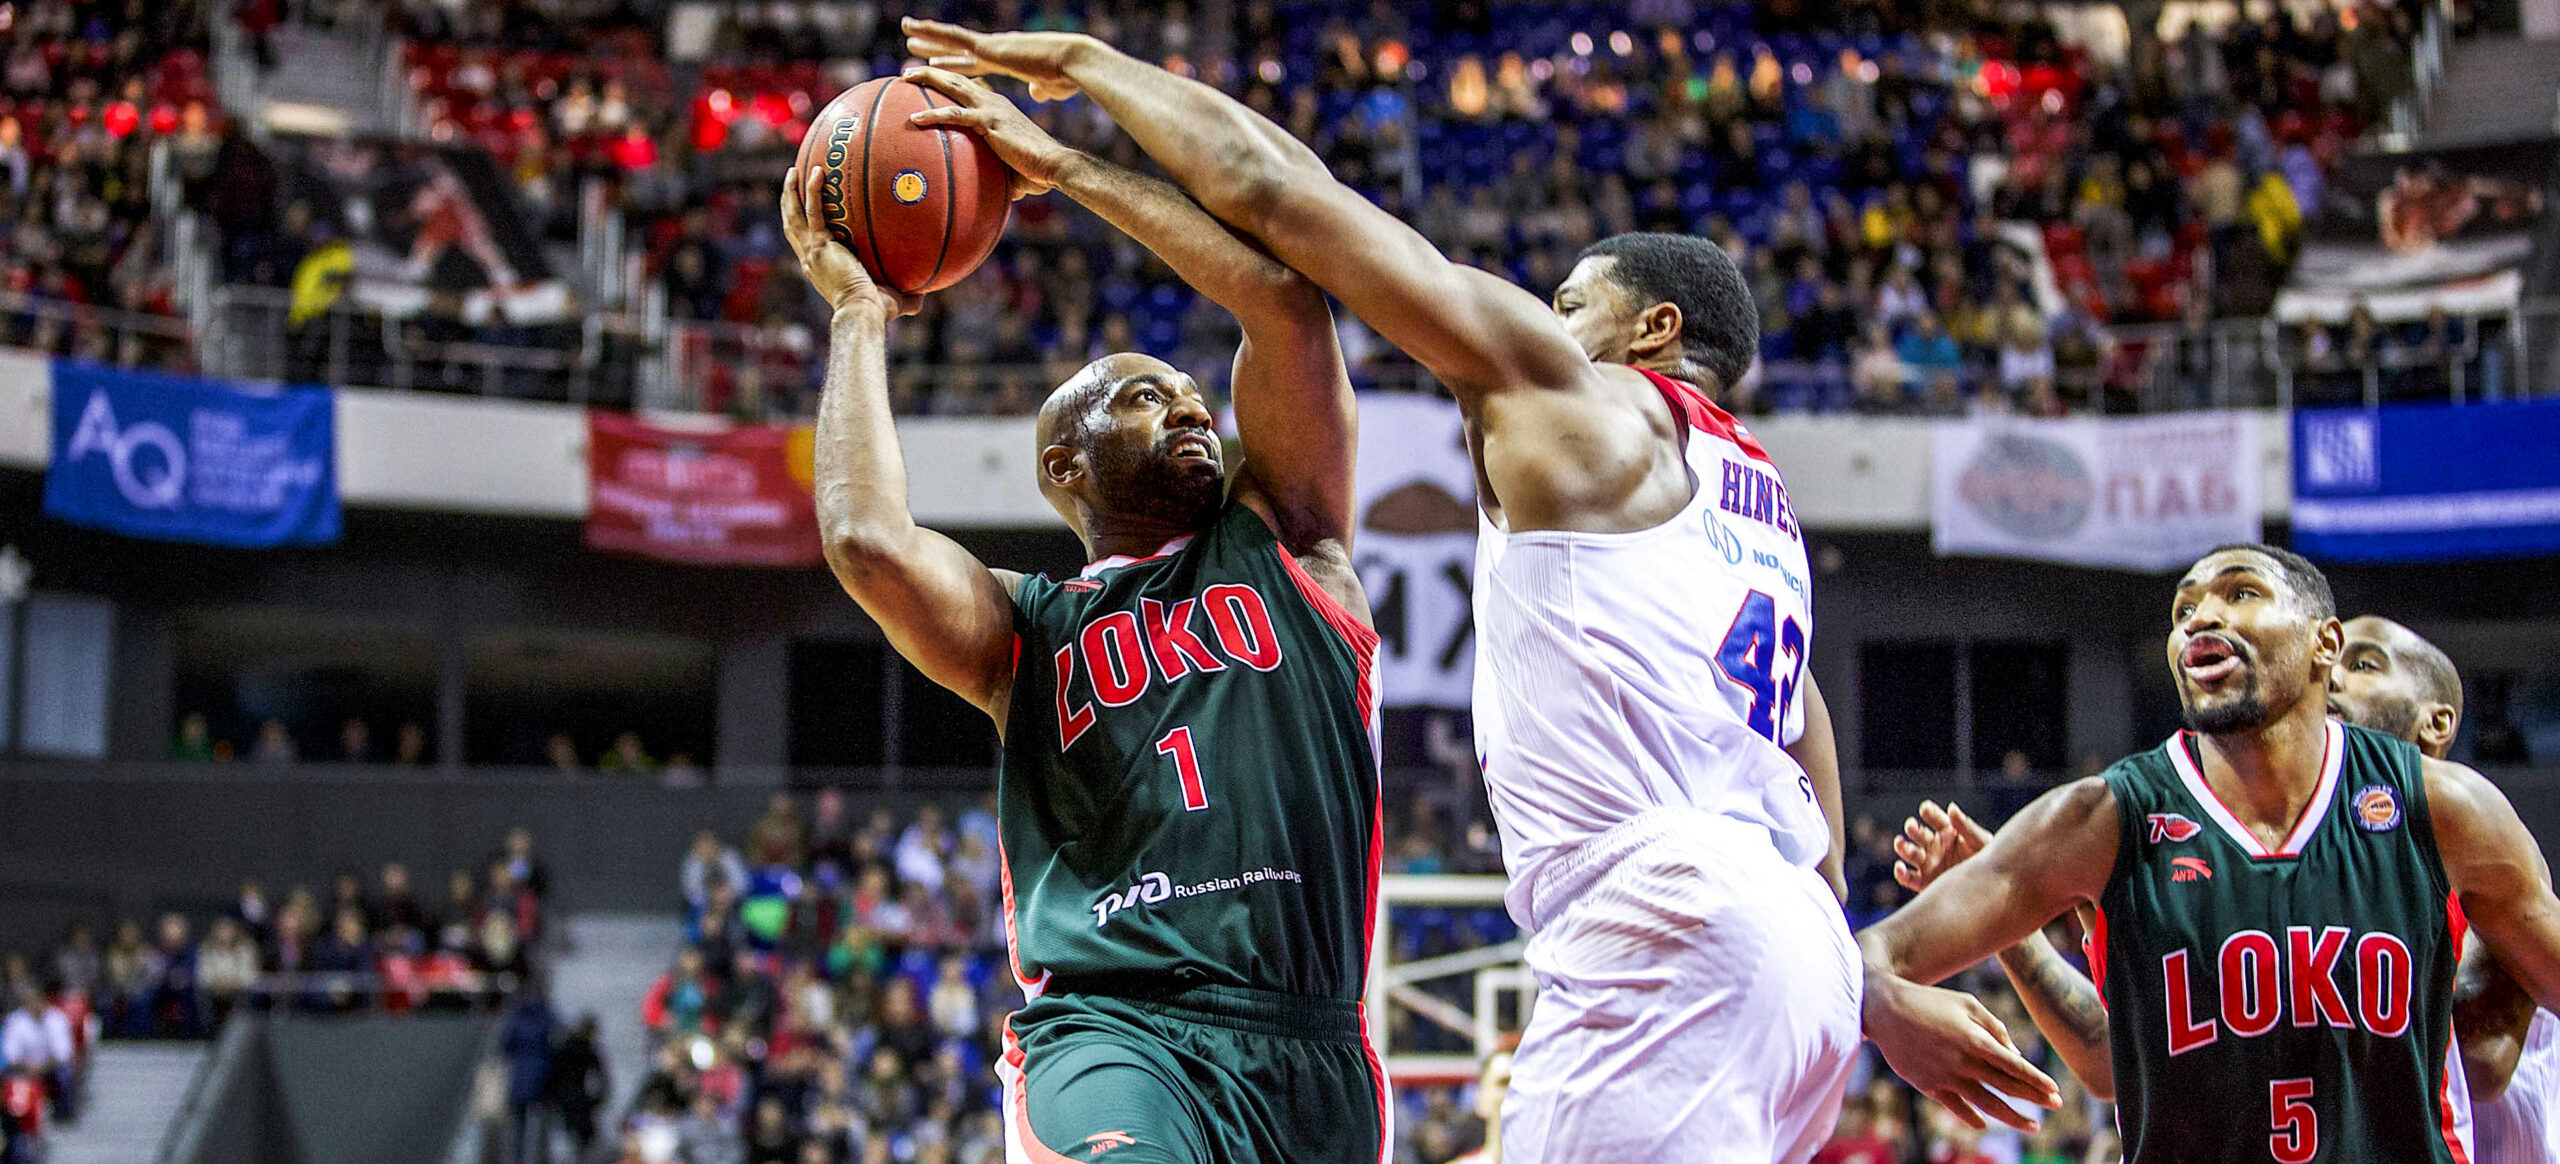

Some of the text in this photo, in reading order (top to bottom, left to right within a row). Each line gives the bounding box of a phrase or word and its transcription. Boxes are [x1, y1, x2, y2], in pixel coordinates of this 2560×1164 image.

[1720, 458, 1799, 542] HINES
[1055, 583, 1283, 753] LOKO
[1715, 588, 1805, 748] 42
[1155, 725, 1209, 812] 1
[1175, 877, 1241, 898] Russian
[2171, 868, 2198, 882] ANTA
[2162, 925, 2413, 1057] LOKO
[1091, 1139, 1119, 1155] ANTA
[2269, 1077, 2319, 1164] 5
